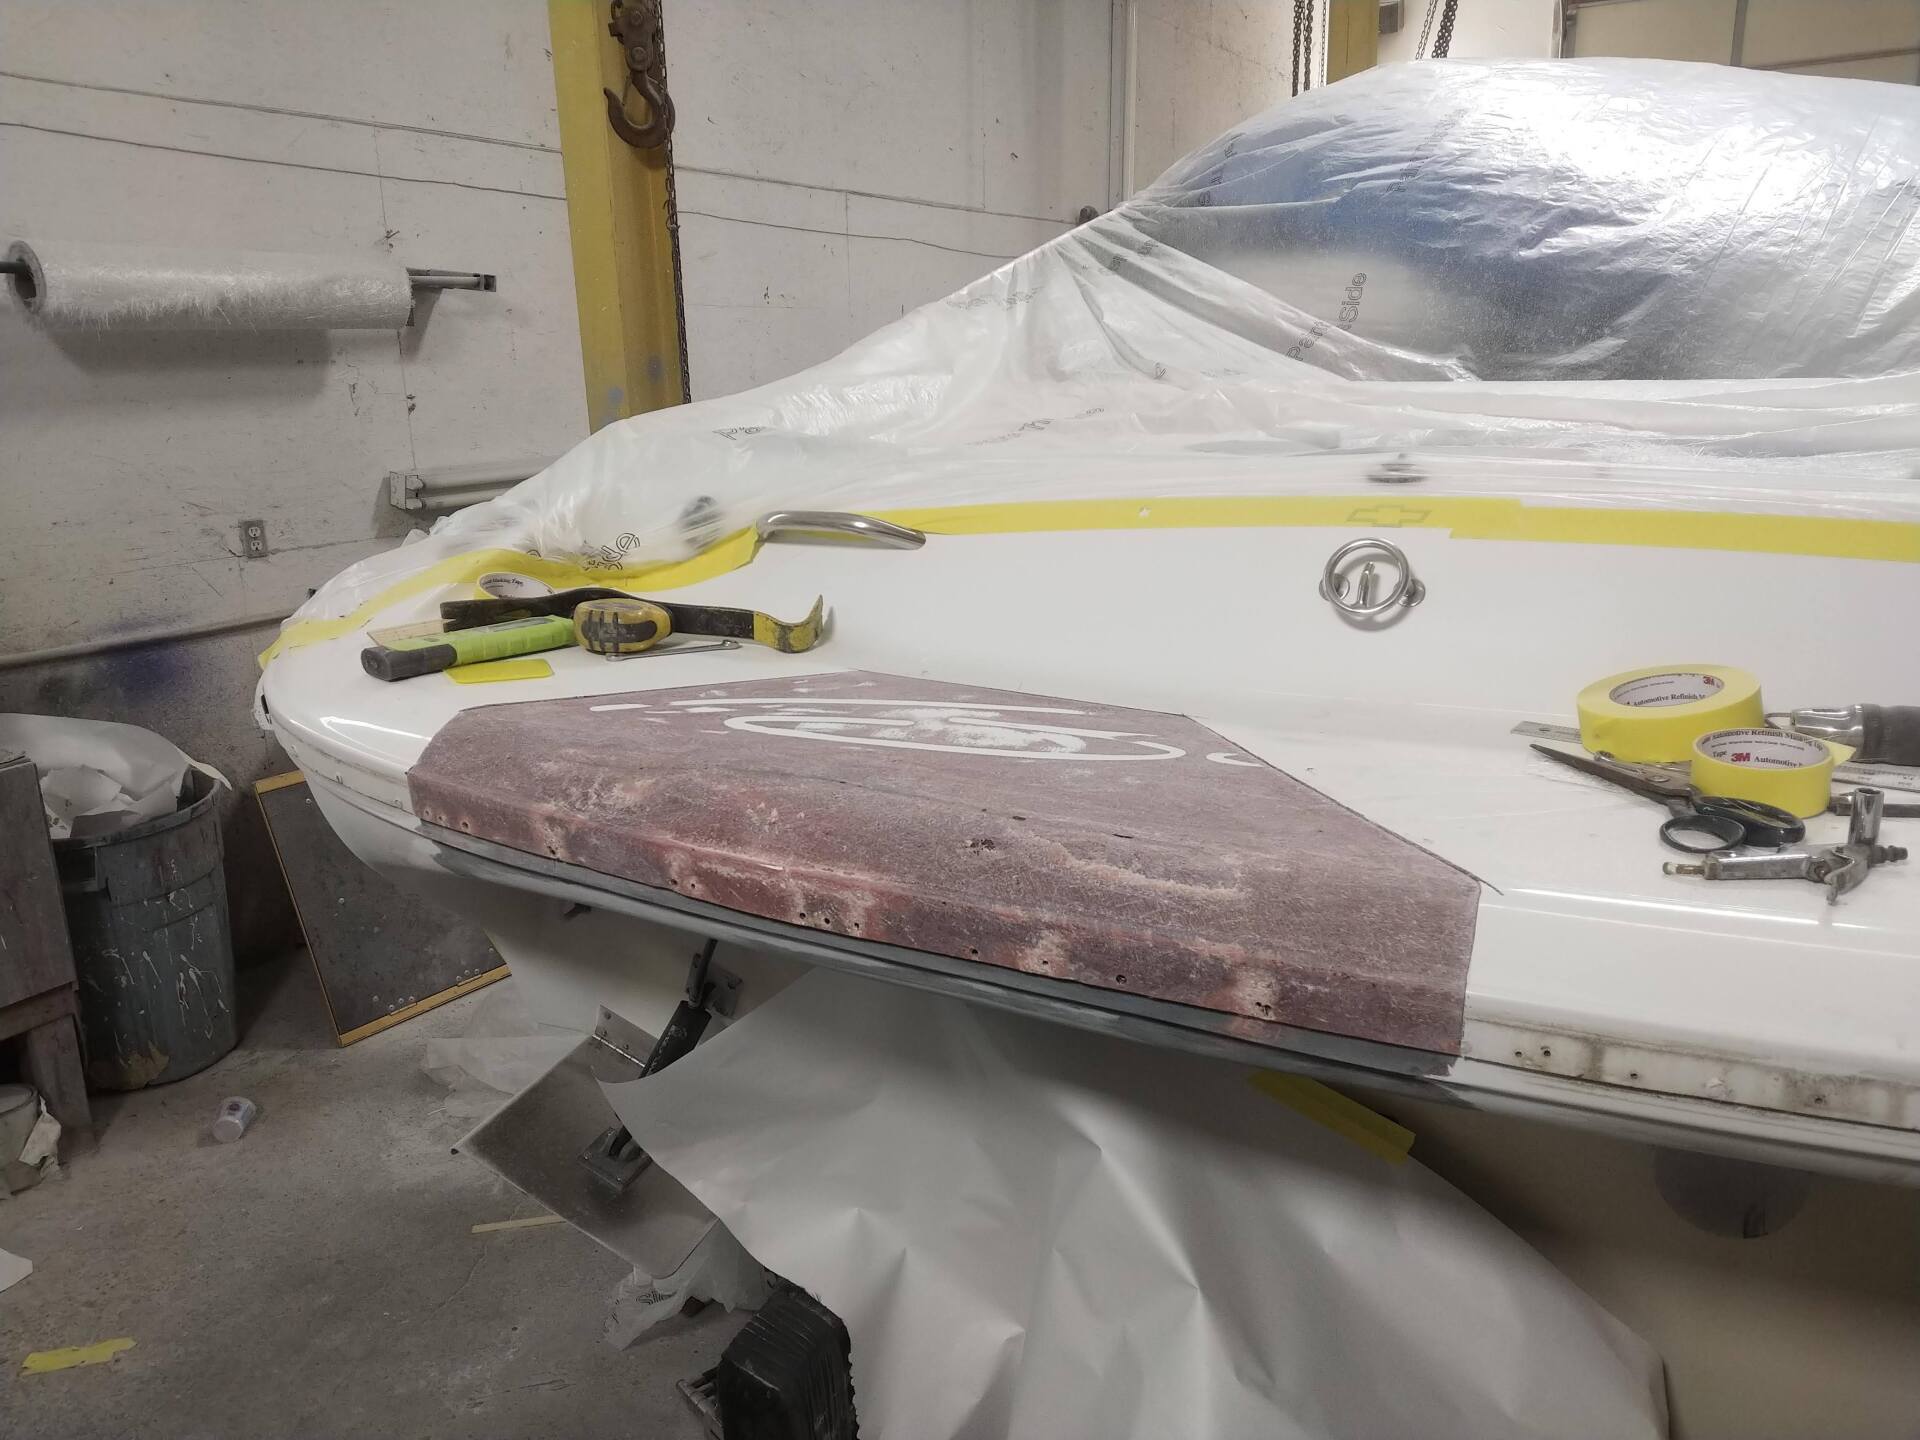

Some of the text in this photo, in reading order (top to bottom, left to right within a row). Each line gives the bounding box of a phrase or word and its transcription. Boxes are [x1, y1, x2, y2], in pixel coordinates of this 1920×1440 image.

[1339, 272, 1367, 322] Side
[1633, 695, 1669, 706] Automotive
[1670, 692, 1698, 701] Refinish
[1712, 751, 1728, 759] Tape
[1731, 752, 1751, 763] 3M
[1754, 756, 1798, 769] Automotive
